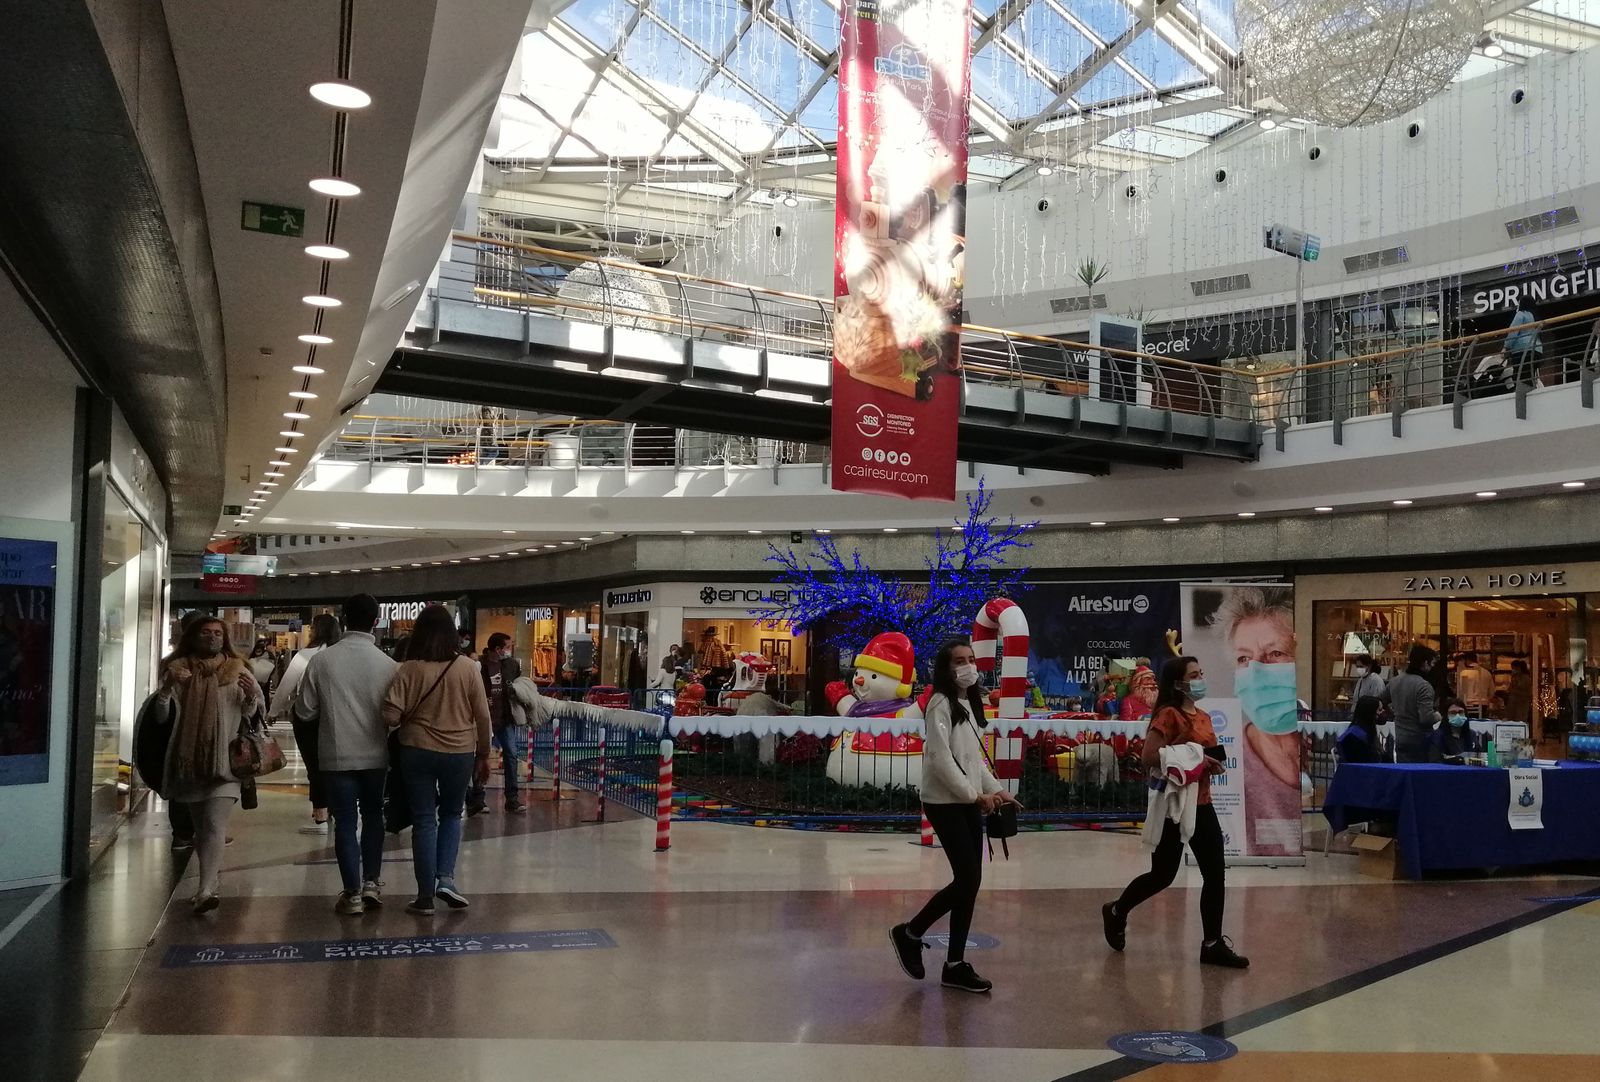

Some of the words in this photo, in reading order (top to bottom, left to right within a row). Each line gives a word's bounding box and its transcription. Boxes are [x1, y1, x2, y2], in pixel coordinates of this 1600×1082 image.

[863, 414, 879, 426] SGS
[886, 413, 915, 422] DISINFECTION
[886, 419, 912, 427] MONITORED
[843, 464, 929, 484] ccairesur.com
[1403, 575, 1474, 592] ZARA
[1487, 570, 1567, 589] HOME
[1067, 595, 1132, 612] AireSur
[525, 607, 552, 625] pimkie
[1074, 656, 1086, 669] LA
[1066, 670, 1073, 683] A
[1075, 671, 1088, 684] LA
[325, 940, 483, 952] DISTANCIA
